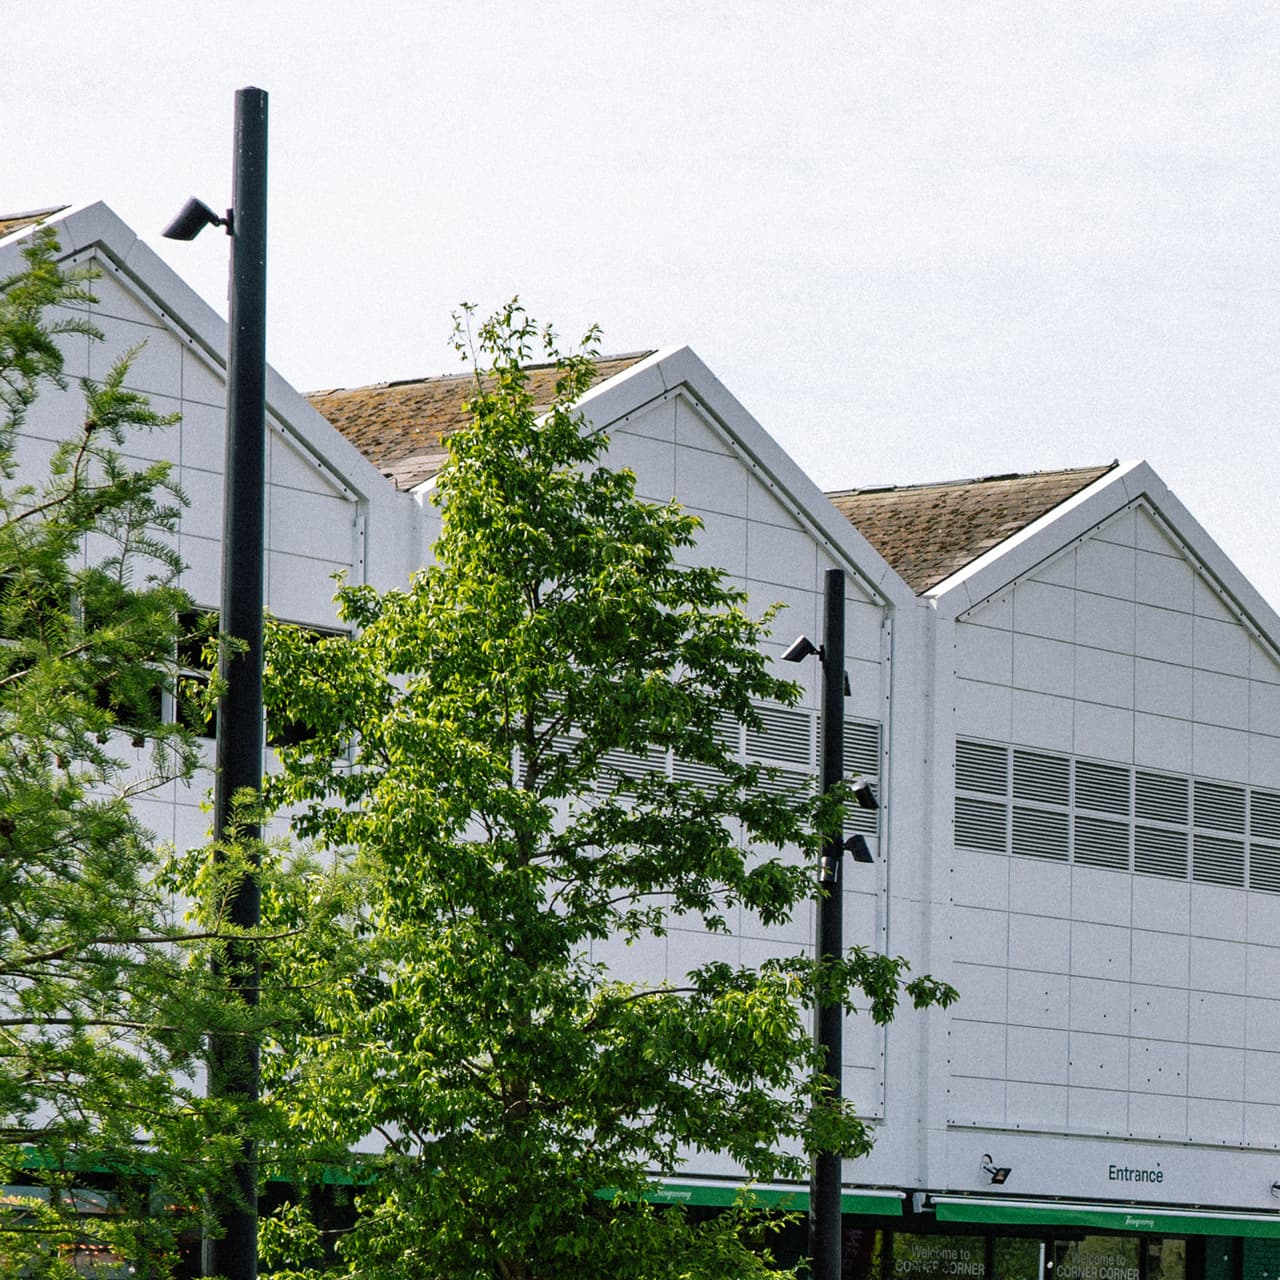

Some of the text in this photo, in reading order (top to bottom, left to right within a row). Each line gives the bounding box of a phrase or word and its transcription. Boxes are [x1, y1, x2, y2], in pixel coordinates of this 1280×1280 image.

[1108, 1164, 1164, 1183] Entrance
[1056, 1265, 1140, 1280] CORNER CORNER
